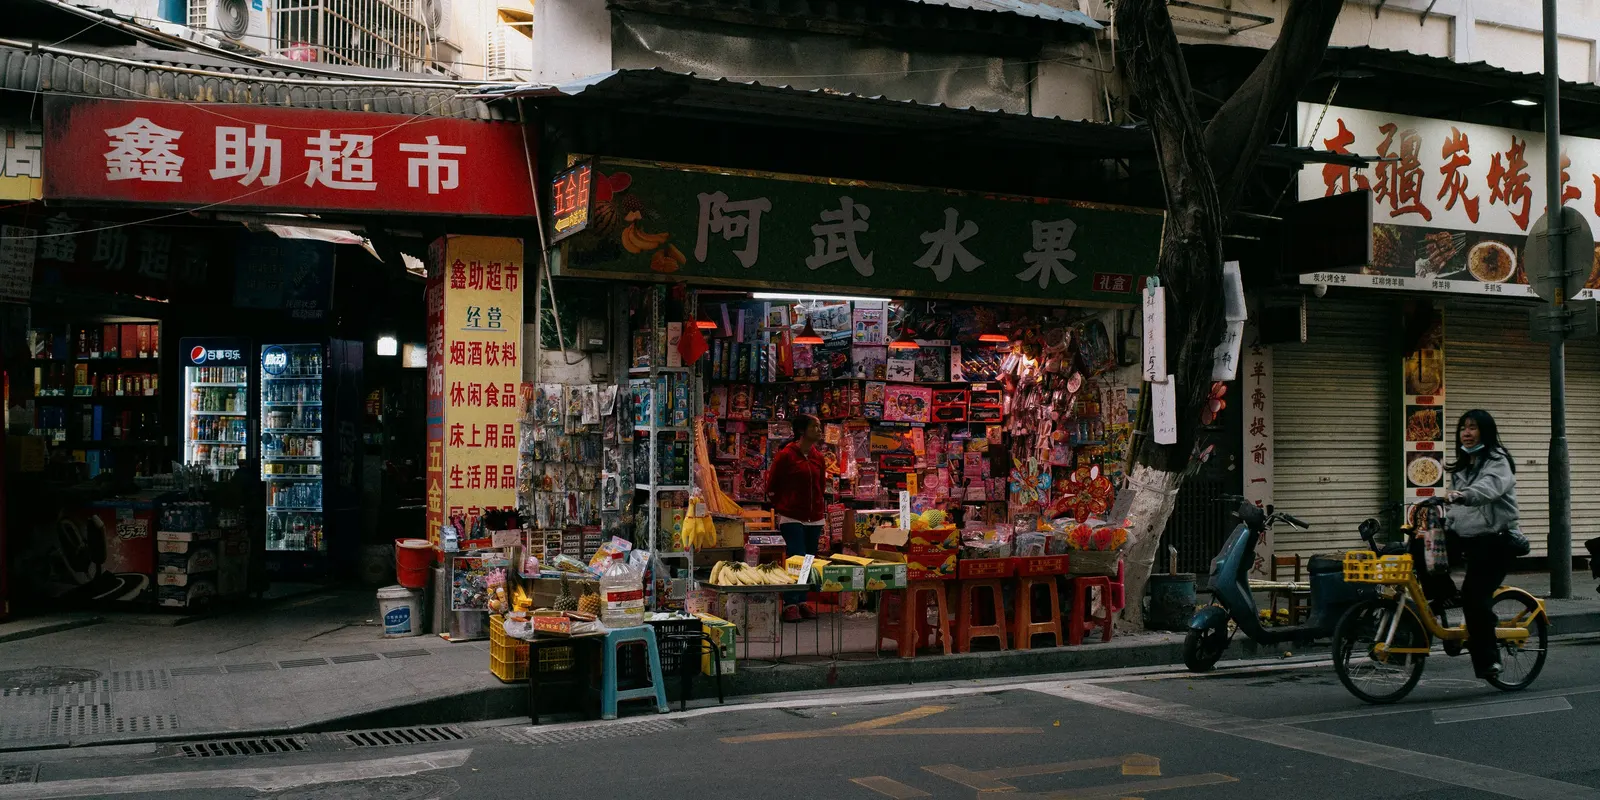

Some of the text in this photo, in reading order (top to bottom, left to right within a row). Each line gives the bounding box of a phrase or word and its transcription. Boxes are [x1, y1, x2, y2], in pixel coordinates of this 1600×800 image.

[103, 116, 468, 195] 鑫助超市
[553, 167, 591, 216] 五金店
[695, 190, 1078, 290] 阿武水果
[450, 258, 519, 292] 鑫助超市
[1099, 275, 1125, 291] 礼盒
[1313, 273, 1346, 283] 炭火烤全羊
[1432, 280, 1451, 289] 烤羊排
[1484, 283, 1502, 293] 手抓饭
[467, 306, 502, 328] 经营
[207, 349, 241, 361] 百事可乐
[450, 340, 517, 367] 烟酒饮料
[450, 381, 517, 408] 休闲食品
[450, 423, 516, 449] 床上用品
[1248, 310, 1269, 577] 全羊需提前一定
[450, 464, 516, 490] 生活用品
[428, 441, 442, 546] 五金店
